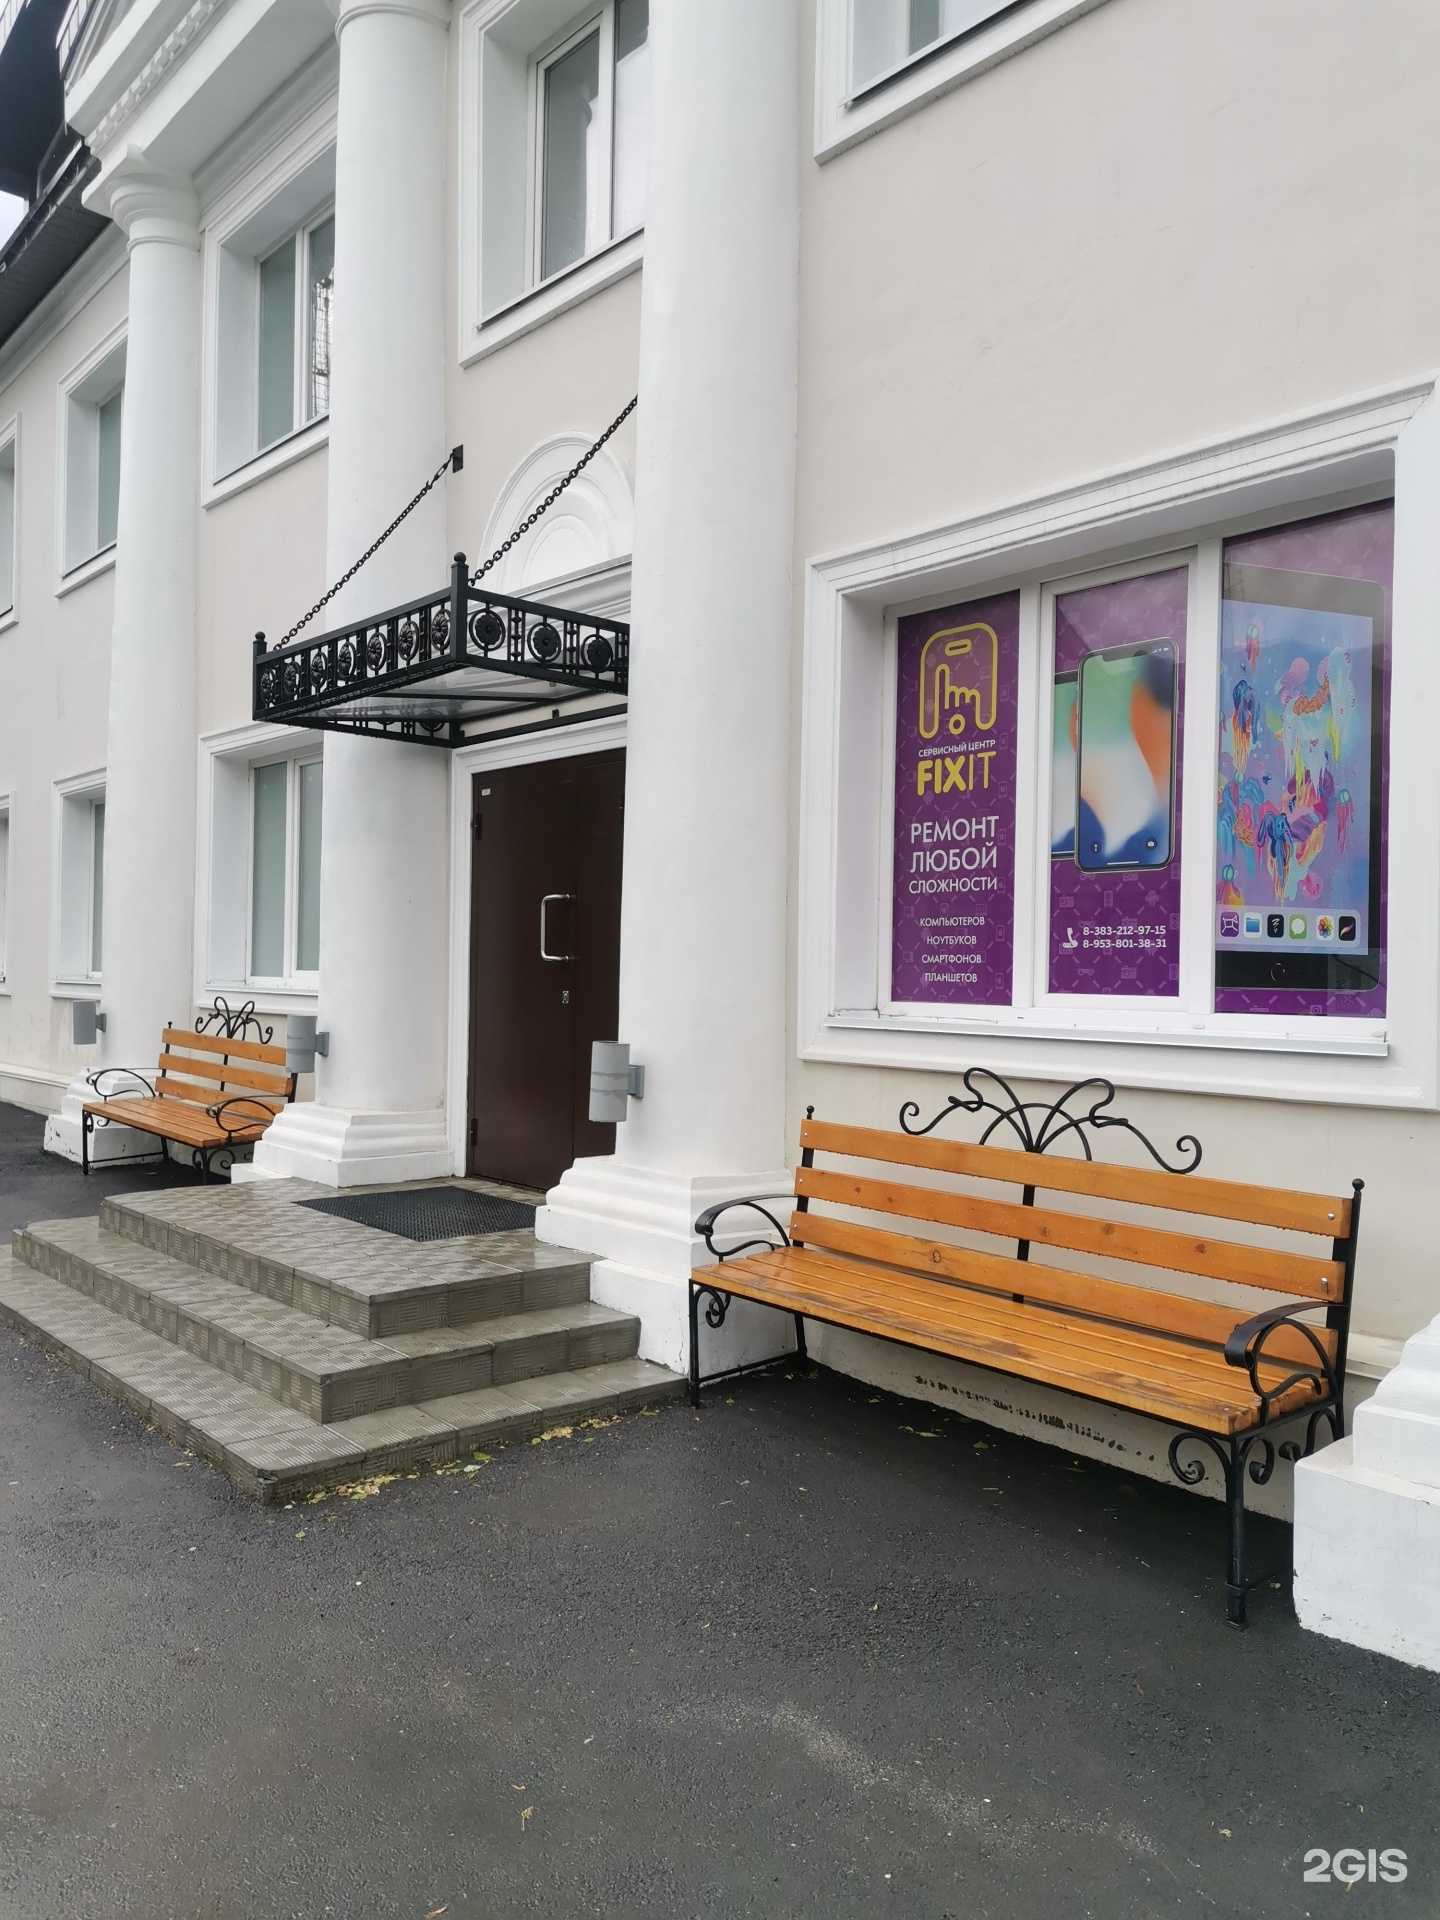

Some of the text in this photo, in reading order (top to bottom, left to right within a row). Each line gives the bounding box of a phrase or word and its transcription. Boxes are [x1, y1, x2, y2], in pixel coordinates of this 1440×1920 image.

[918, 739, 996, 758] СЕРВИСНЫЙ ЦЕНТР
[917, 751, 997, 796] FIXIT
[911, 816, 999, 844] РЕМОНТ
[910, 841, 998, 873] ЛЮБОЙ
[908, 877, 998, 894] СЛОЖНОСТИ
[920, 916, 985, 927] КОМПЬЮТЕРОВ
[1082, 925, 1167, 936] 8-383-212-97-15
[926, 935, 977, 945] НОУТБУКОВ
[1082, 938, 1167, 949] 8-953-801-38-31
[921, 954, 982, 964] СМАРТФОНОВ
[925, 972, 978, 983] ПЛАНШЕТОВ
